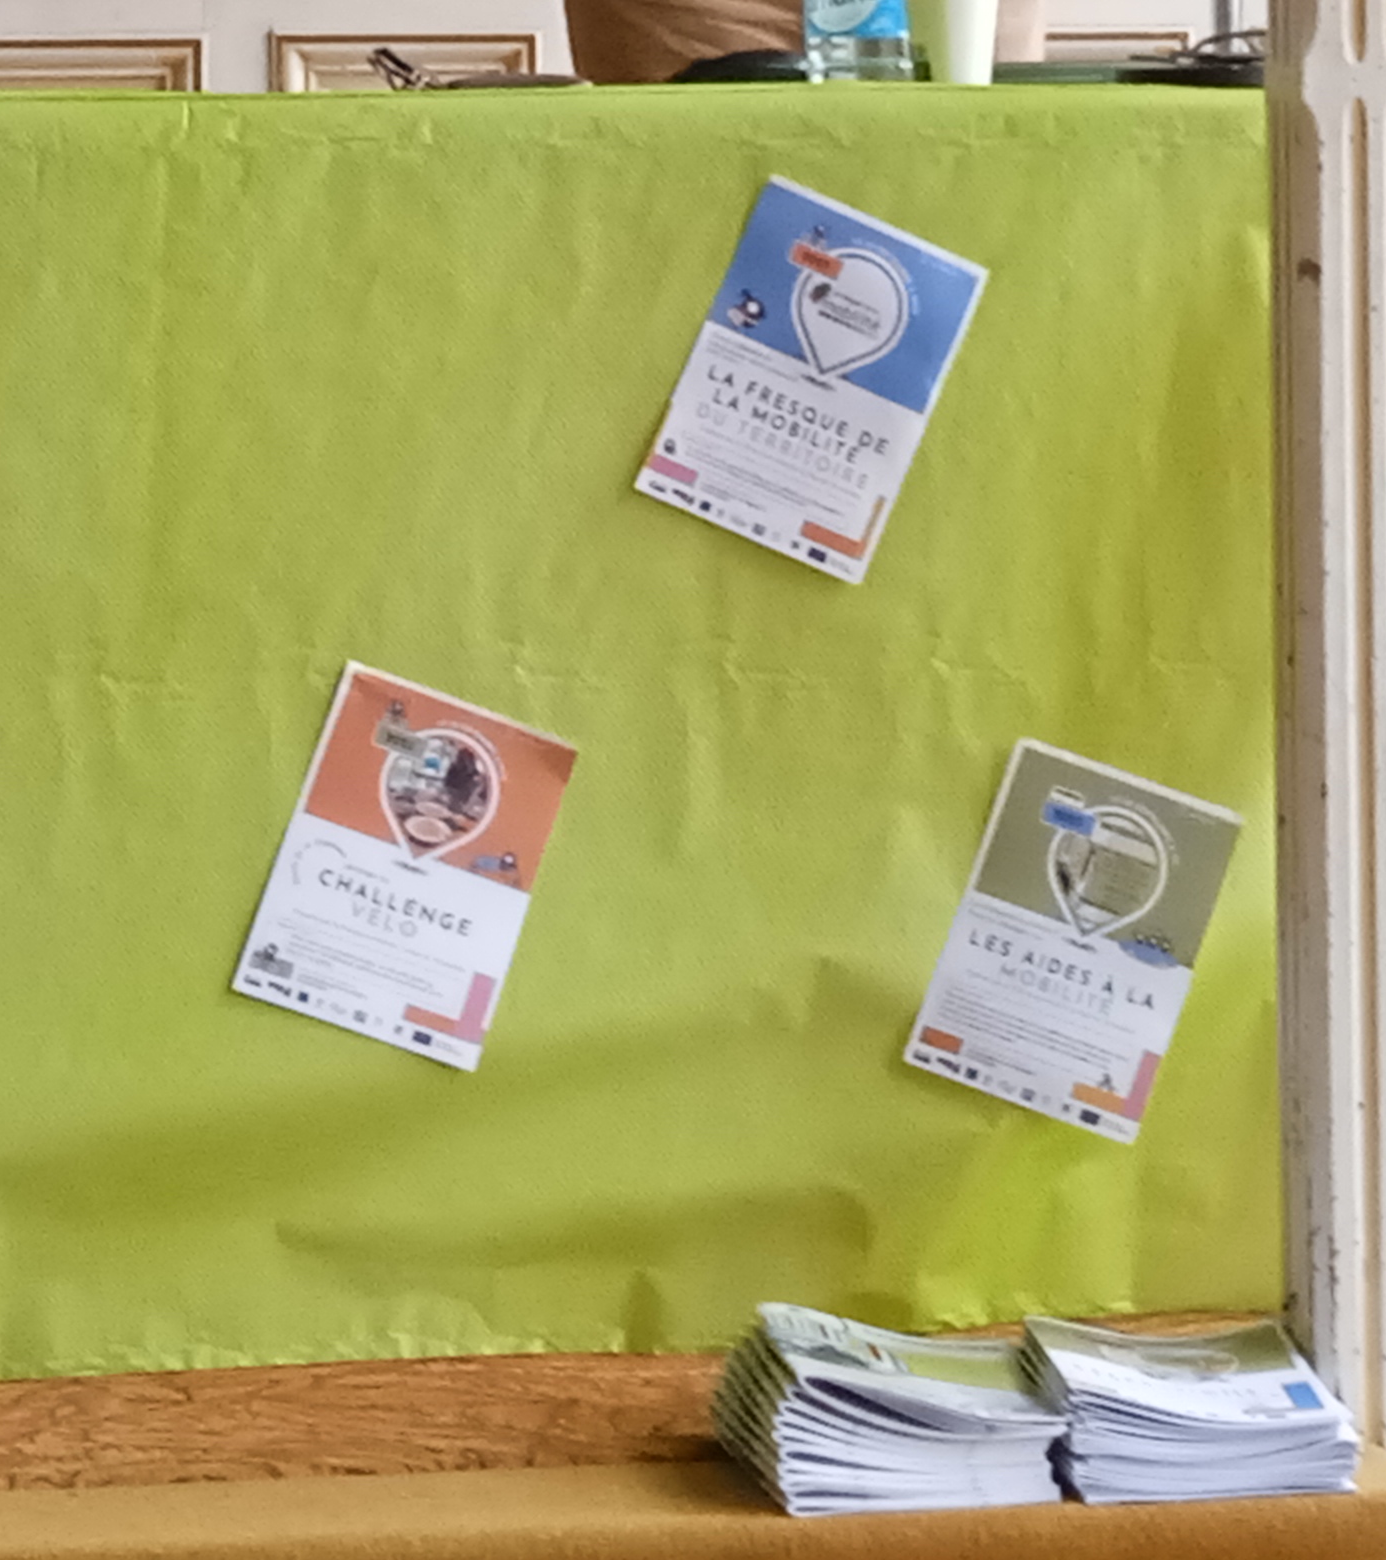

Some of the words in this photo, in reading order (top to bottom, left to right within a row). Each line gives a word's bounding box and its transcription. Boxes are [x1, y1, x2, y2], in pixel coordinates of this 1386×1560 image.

[707, 365, 734, 387] LA
[745, 380, 850, 439] FRESQUE
[860, 427, 890, 456] DE
[712, 389, 740, 413] LA
[737, 419, 870, 491] TERRITOIRE
[319, 868, 473, 937] CHALLENGE
[968, 928, 1012, 958] LES
[1021, 949, 1093, 987] AIDES
[1127, 988, 1154, 1010] LA
